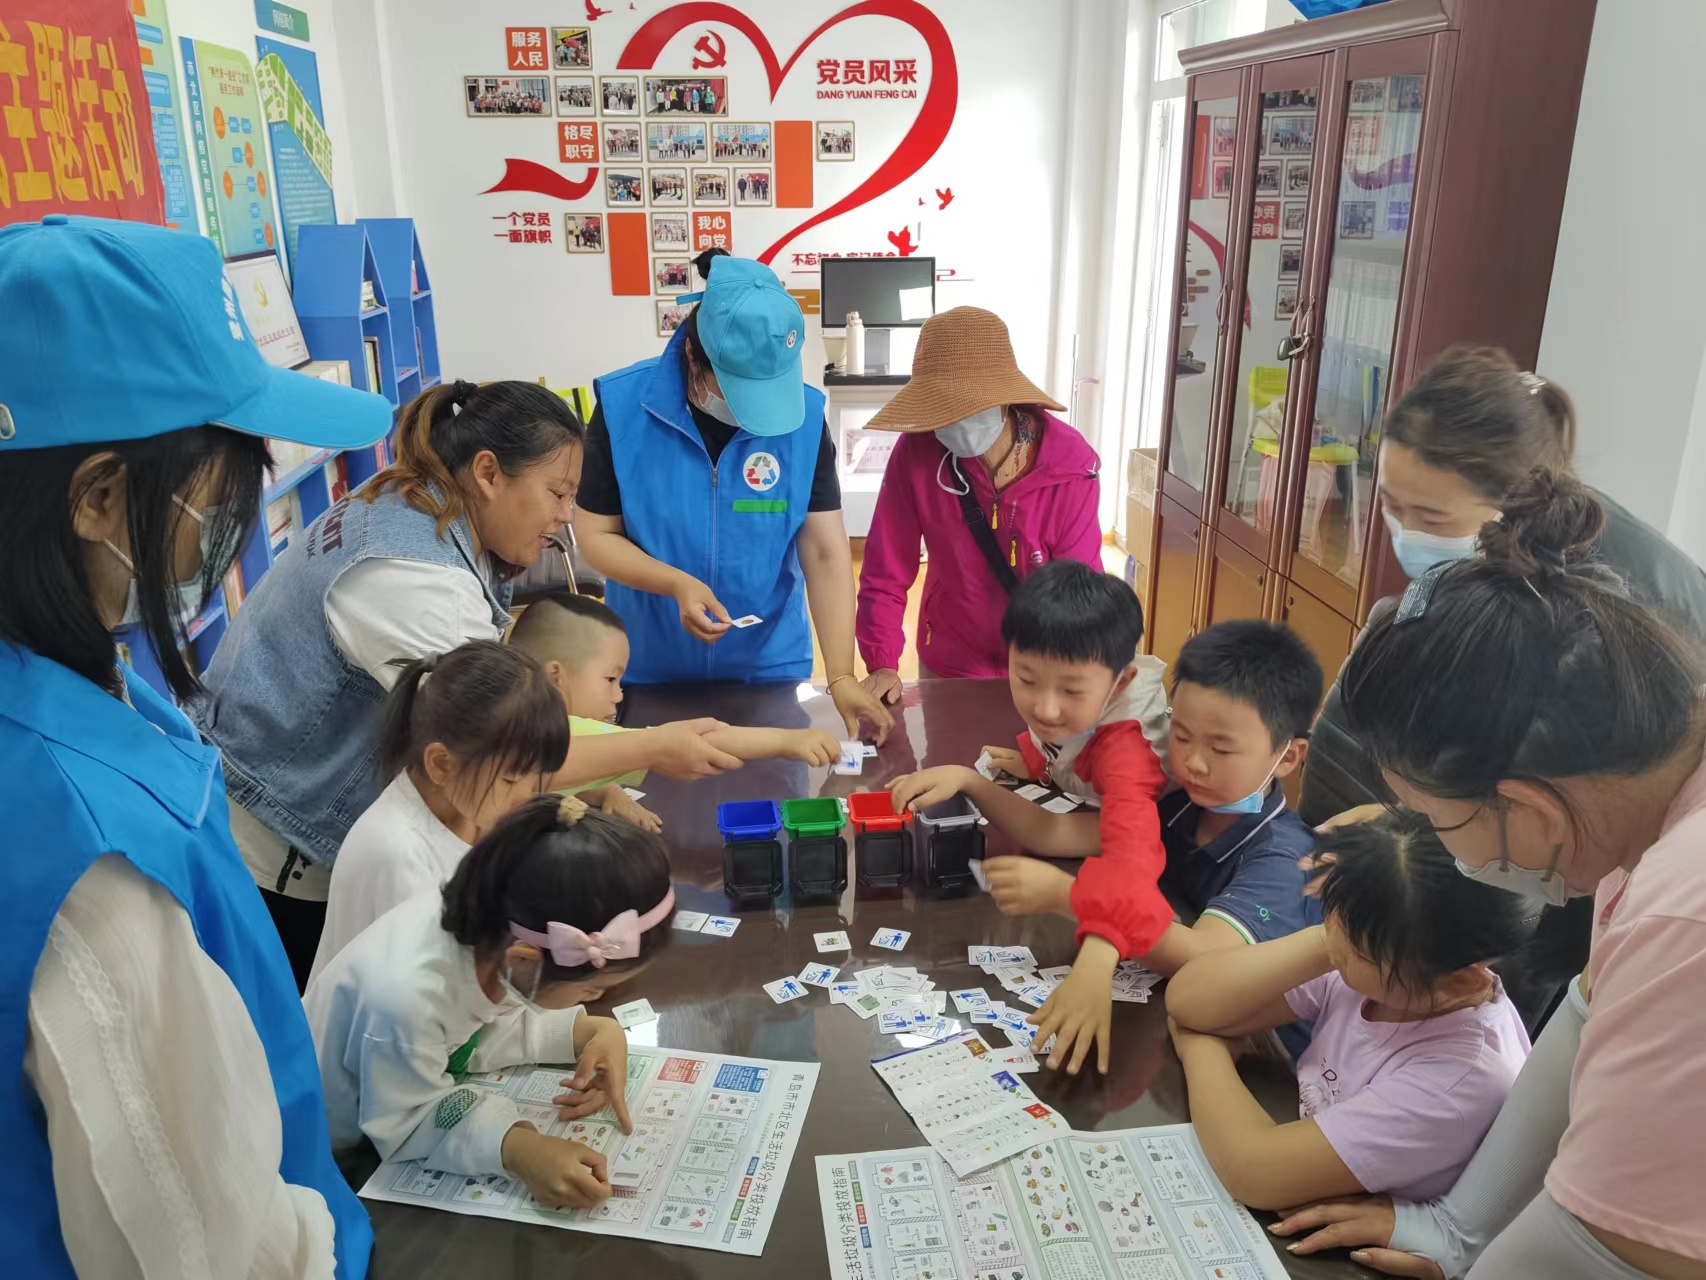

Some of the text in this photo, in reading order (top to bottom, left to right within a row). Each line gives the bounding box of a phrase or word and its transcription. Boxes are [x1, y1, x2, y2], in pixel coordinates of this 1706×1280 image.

[511, 31, 541, 47] 服务
[513, 51, 543, 67] 人民
[816, 59, 917, 85] 党员风采
[816, 89, 917, 99] DANG YUAN FENG CAI
[0, 20, 144, 208] 主题活动
[565, 144, 595, 159] 职守
[492, 211, 551, 226] 一个党员
[698, 216, 726, 230] 我心
[493, 229, 552, 244] 一面旗帜
[698, 233, 726, 248] 向党
